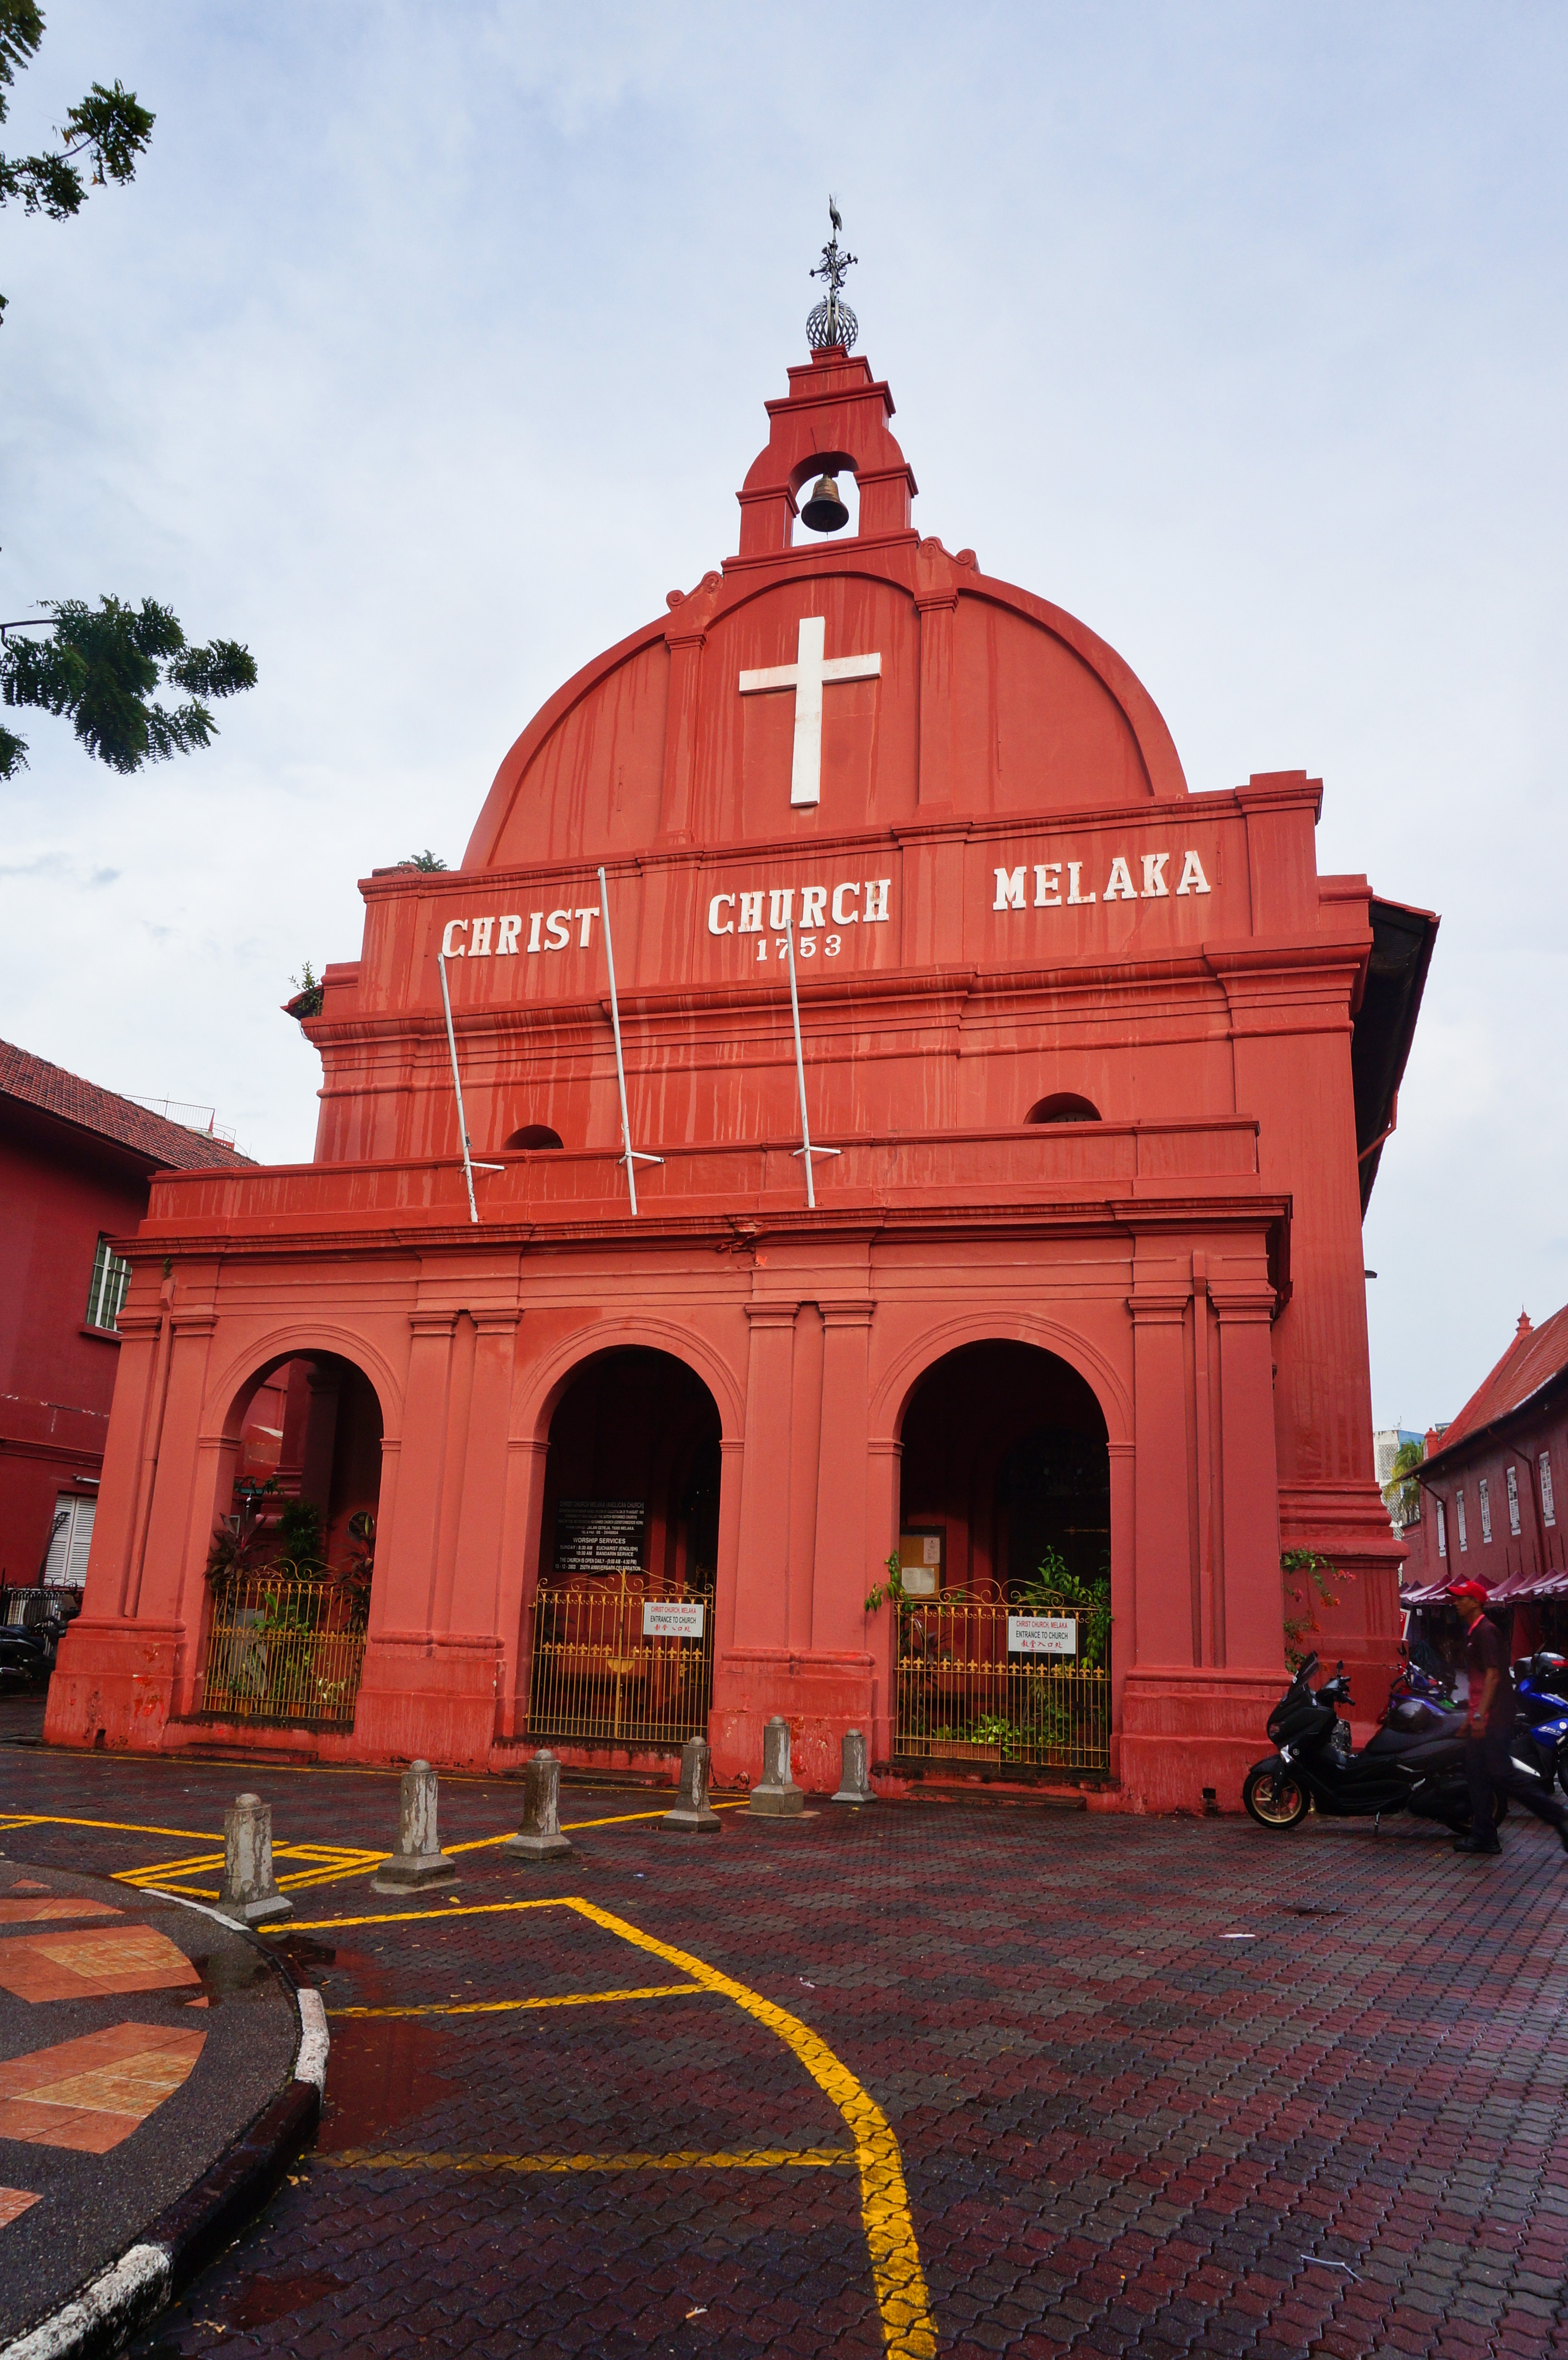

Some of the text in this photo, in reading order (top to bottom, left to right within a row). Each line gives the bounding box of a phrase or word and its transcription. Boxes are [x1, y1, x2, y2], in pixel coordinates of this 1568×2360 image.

[441, 850, 1211, 958] CHRIST CHURCH MELAKA
[757, 934, 841, 961] 1753
[1021, 1639, 1063, 1648] 教堂入口处
